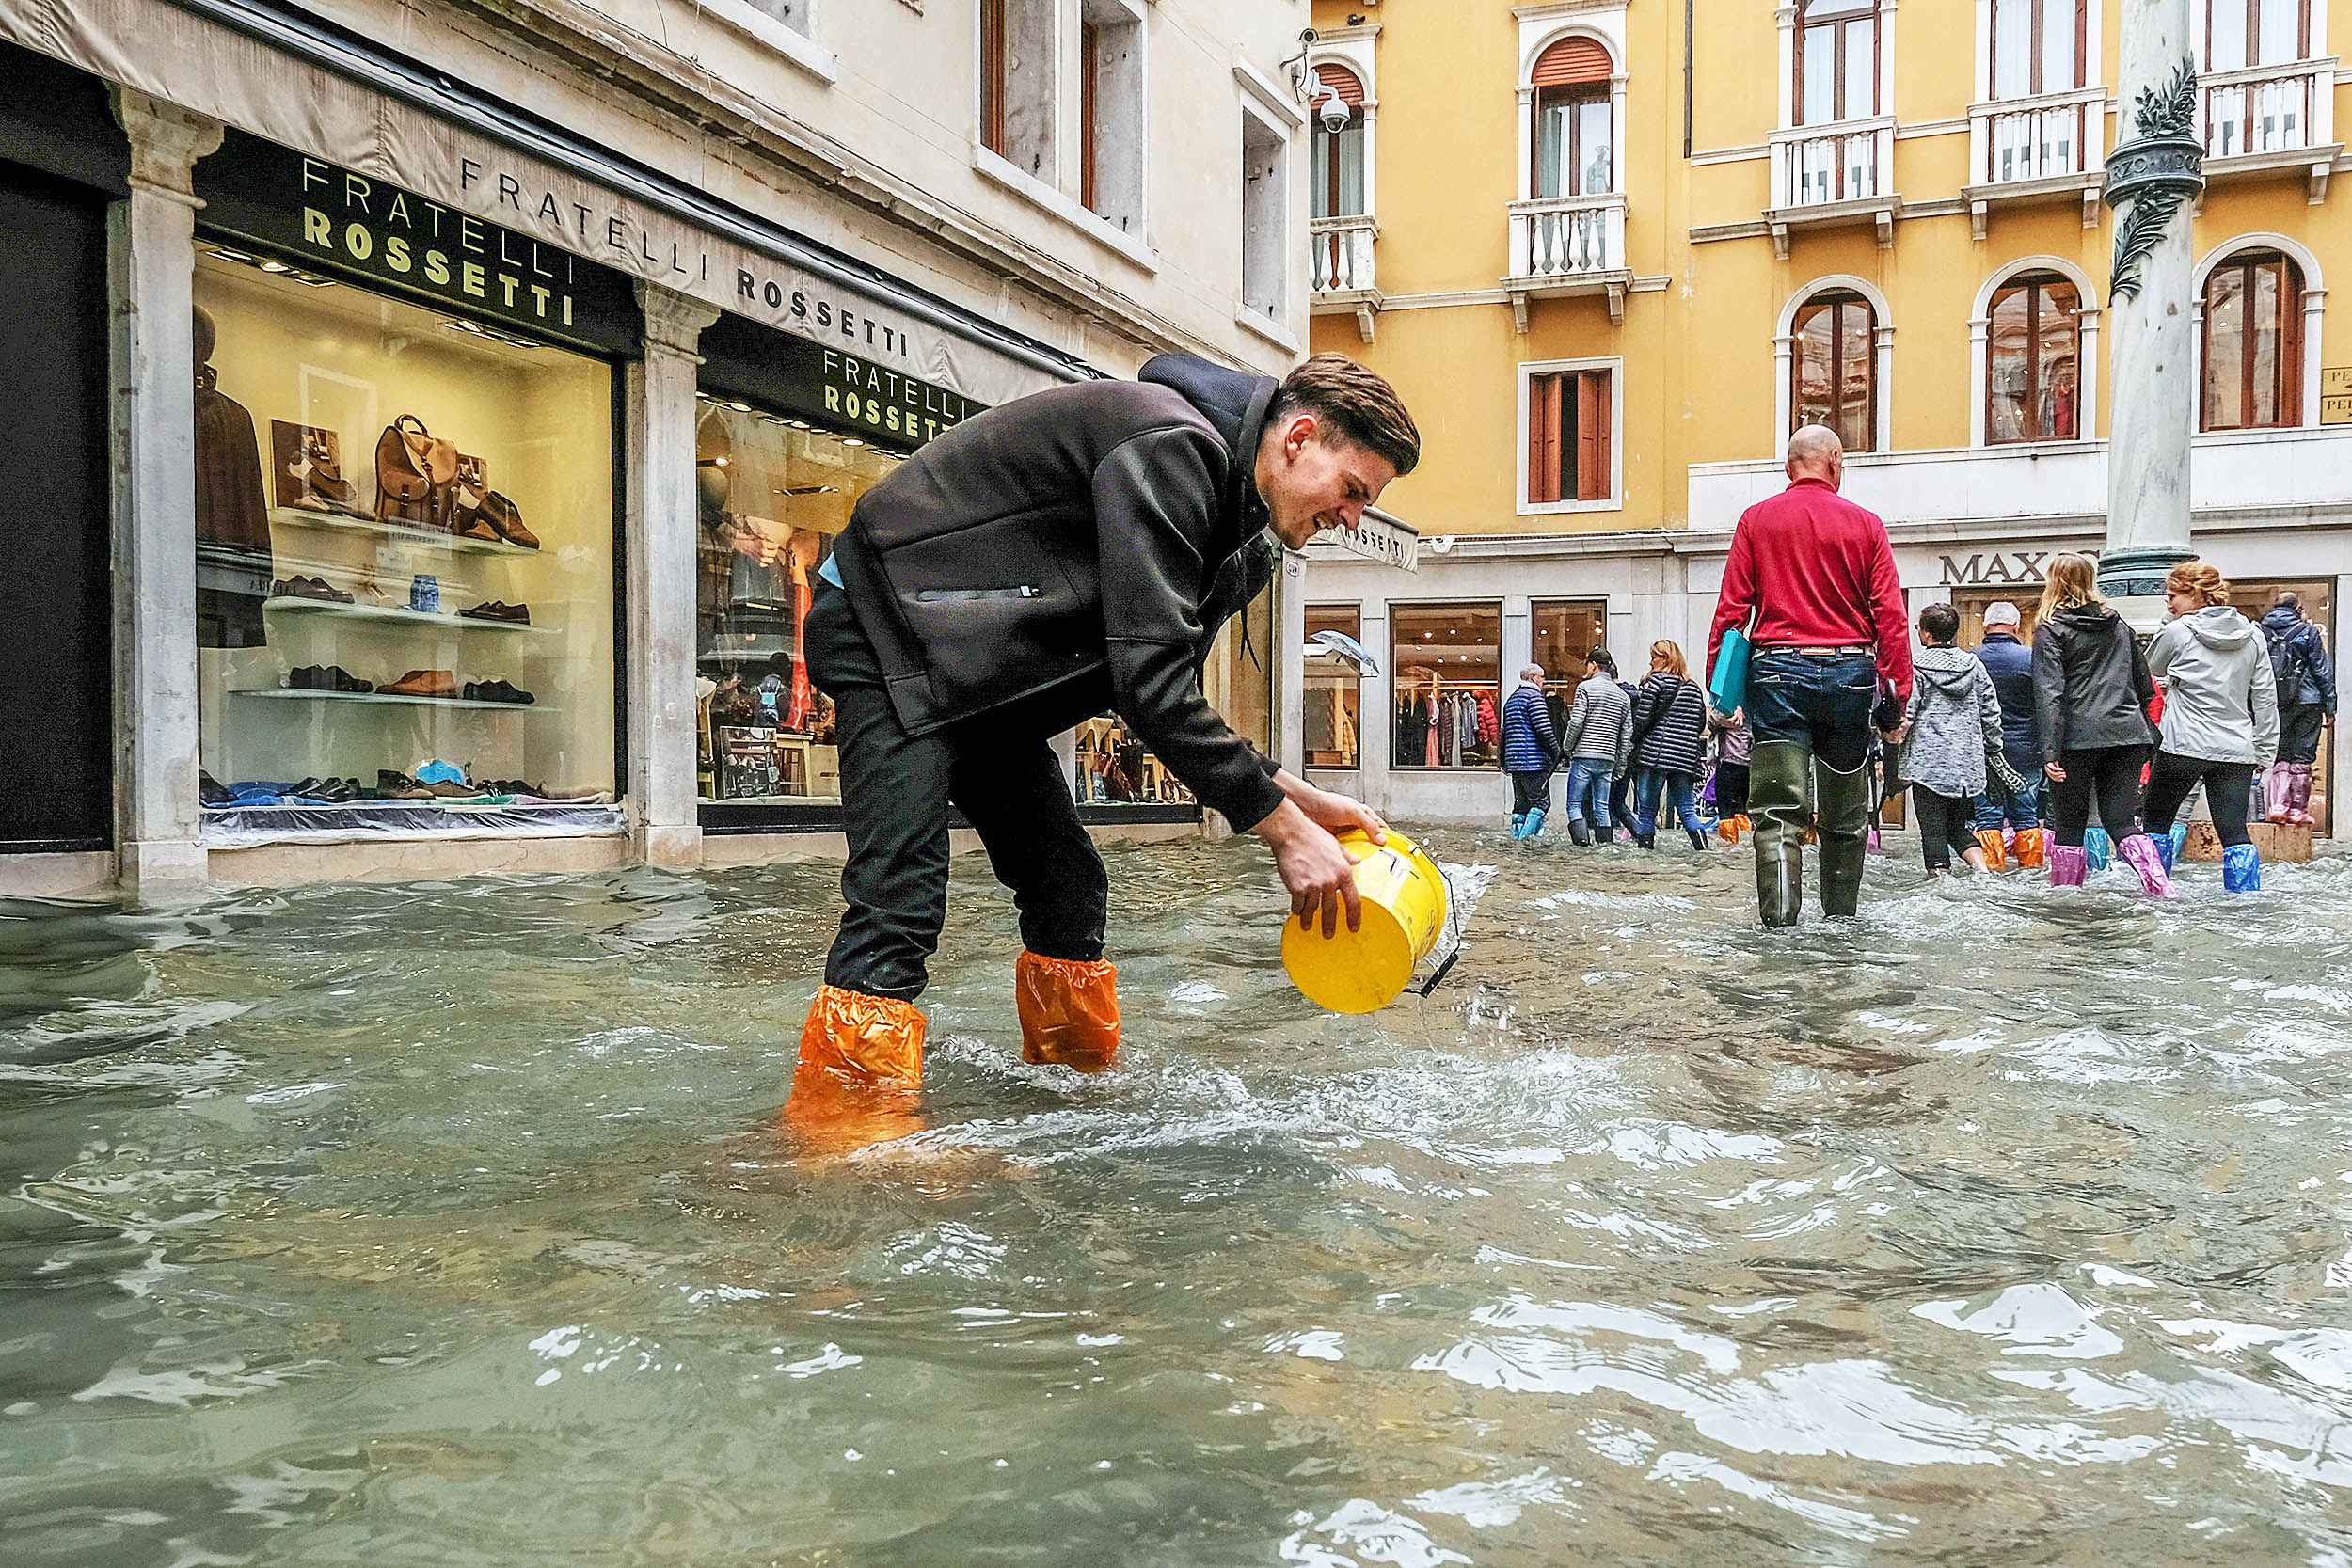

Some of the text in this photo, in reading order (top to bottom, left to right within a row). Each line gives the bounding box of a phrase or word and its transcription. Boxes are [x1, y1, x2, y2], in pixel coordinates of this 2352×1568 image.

[303, 157, 572, 284] FRATELLI
[303, 206, 573, 326] ROSSETTI
[461, 157, 908, 356] FRATELLI ROSSETTI
[824, 349, 965, 422] FRATELLI
[824, 384, 953, 443] ROSSET
[1938, 551, 2049, 585] MAX
